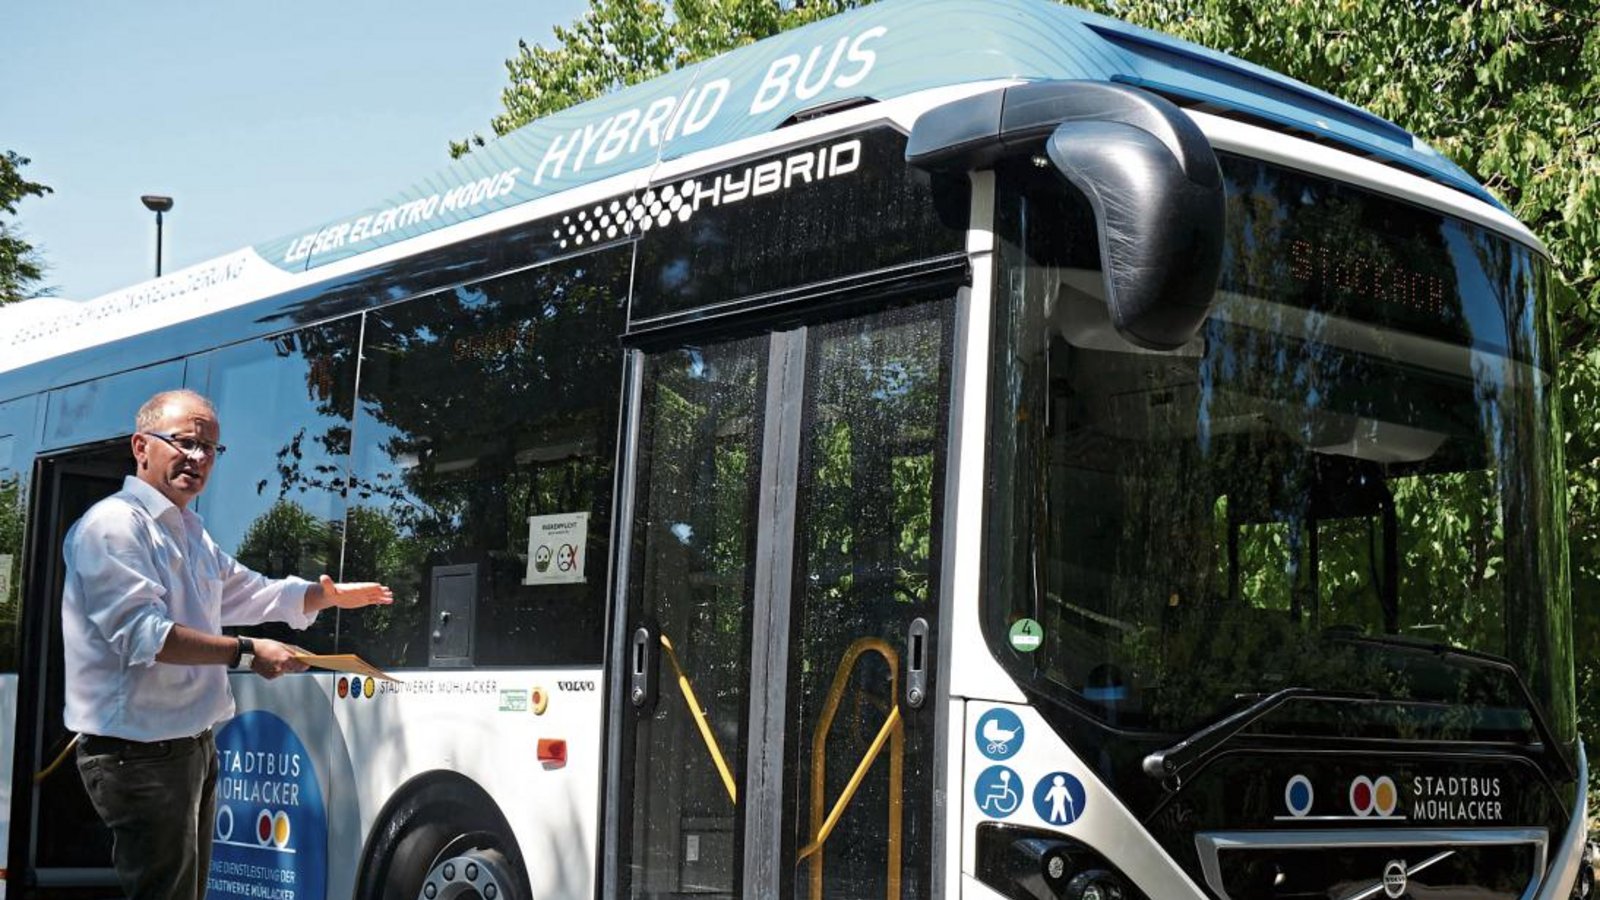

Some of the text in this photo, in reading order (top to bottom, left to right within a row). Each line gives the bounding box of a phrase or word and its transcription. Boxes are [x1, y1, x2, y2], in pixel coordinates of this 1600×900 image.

[532, 26, 887, 186] HYBRID BUS
[692, 140, 861, 211] HYBRID
[284, 167, 521, 262] LEISER ELEKTRO MODUS
[1021, 620, 1031, 635] 4
[380, 681, 433, 694] STADTWERKE
[557, 681, 595, 691] VOLVO
[1413, 776, 1501, 797] STADTBUS
[280, 869, 296, 884] DER
